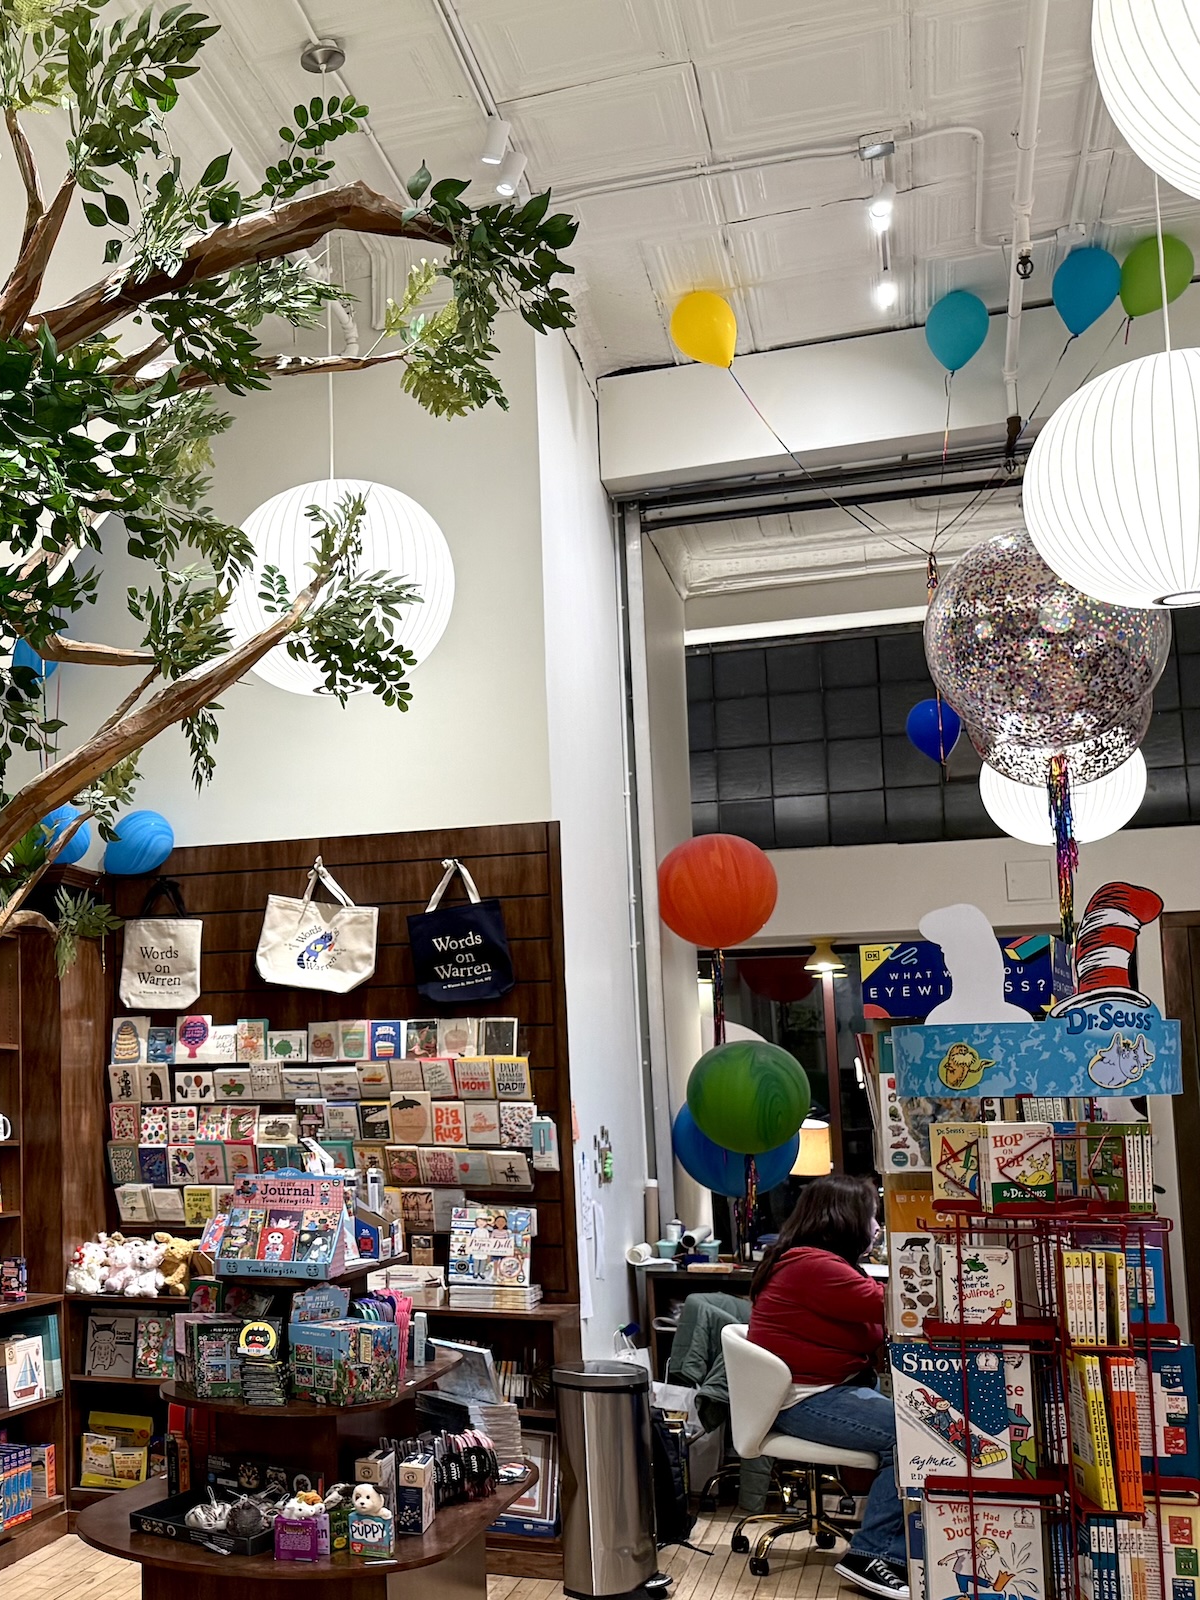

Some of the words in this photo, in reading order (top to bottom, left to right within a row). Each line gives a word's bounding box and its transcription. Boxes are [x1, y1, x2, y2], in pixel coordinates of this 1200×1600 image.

[296, 925, 322, 942] Words
[432, 931, 483, 952] Words
[140, 946, 179, 960] Words
[455, 952, 475, 964] on
[866, 952, 879, 960] DK
[155, 963, 170, 974] on
[433, 962, 492, 980] Warren
[889, 970, 932, 981] WHAT
[137, 972, 181, 987] Warren
[1099, 1003, 1155, 1031] Seuss
[434, 1107, 461, 1125] Big
[991, 1133, 1023, 1149] HOP
[994, 1153, 1025, 1169] POP
[260, 1183, 316, 1197] Journal
[1009, 1188, 1024, 1198] Dr.
[975, 1275, 988, 1283] you
[307, 1300, 335, 1310] PUZZLES
[314, 1295, 329, 1303] MINI
[902, 1352, 970, 1373] Snow
[936, 1505, 946, 1517] I
[983, 1512, 1000, 1522] Had
[983, 1523, 1013, 1540] Feet
